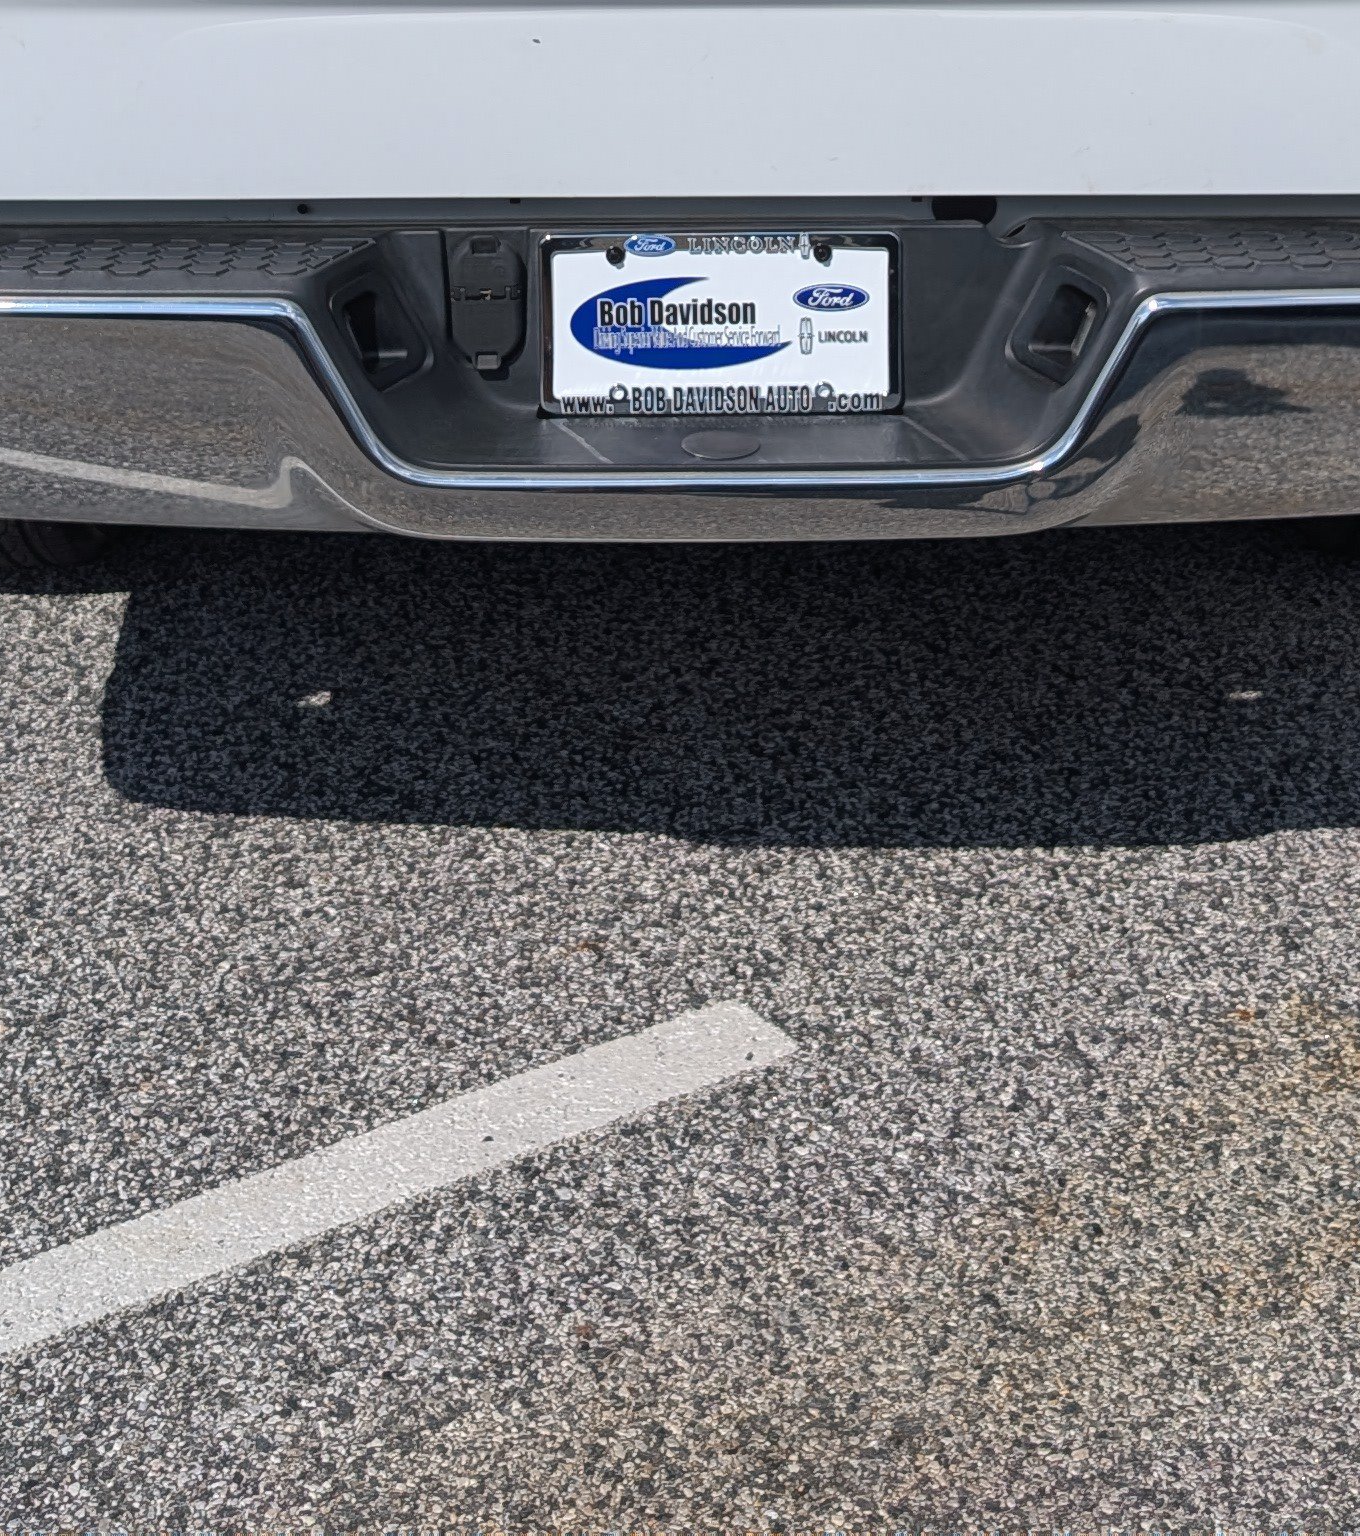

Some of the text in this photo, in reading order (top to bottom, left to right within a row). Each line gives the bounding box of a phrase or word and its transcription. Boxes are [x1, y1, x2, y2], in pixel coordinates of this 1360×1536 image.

[687, 237, 796, 255] LINCOLN
[599, 297, 756, 327] Bob Davidson
[817, 330, 869, 344] LINCOLN
[630, 385, 666, 414] BOB
[670, 383, 761, 414] DAVIDSON
[763, 382, 813, 413] AUTO
